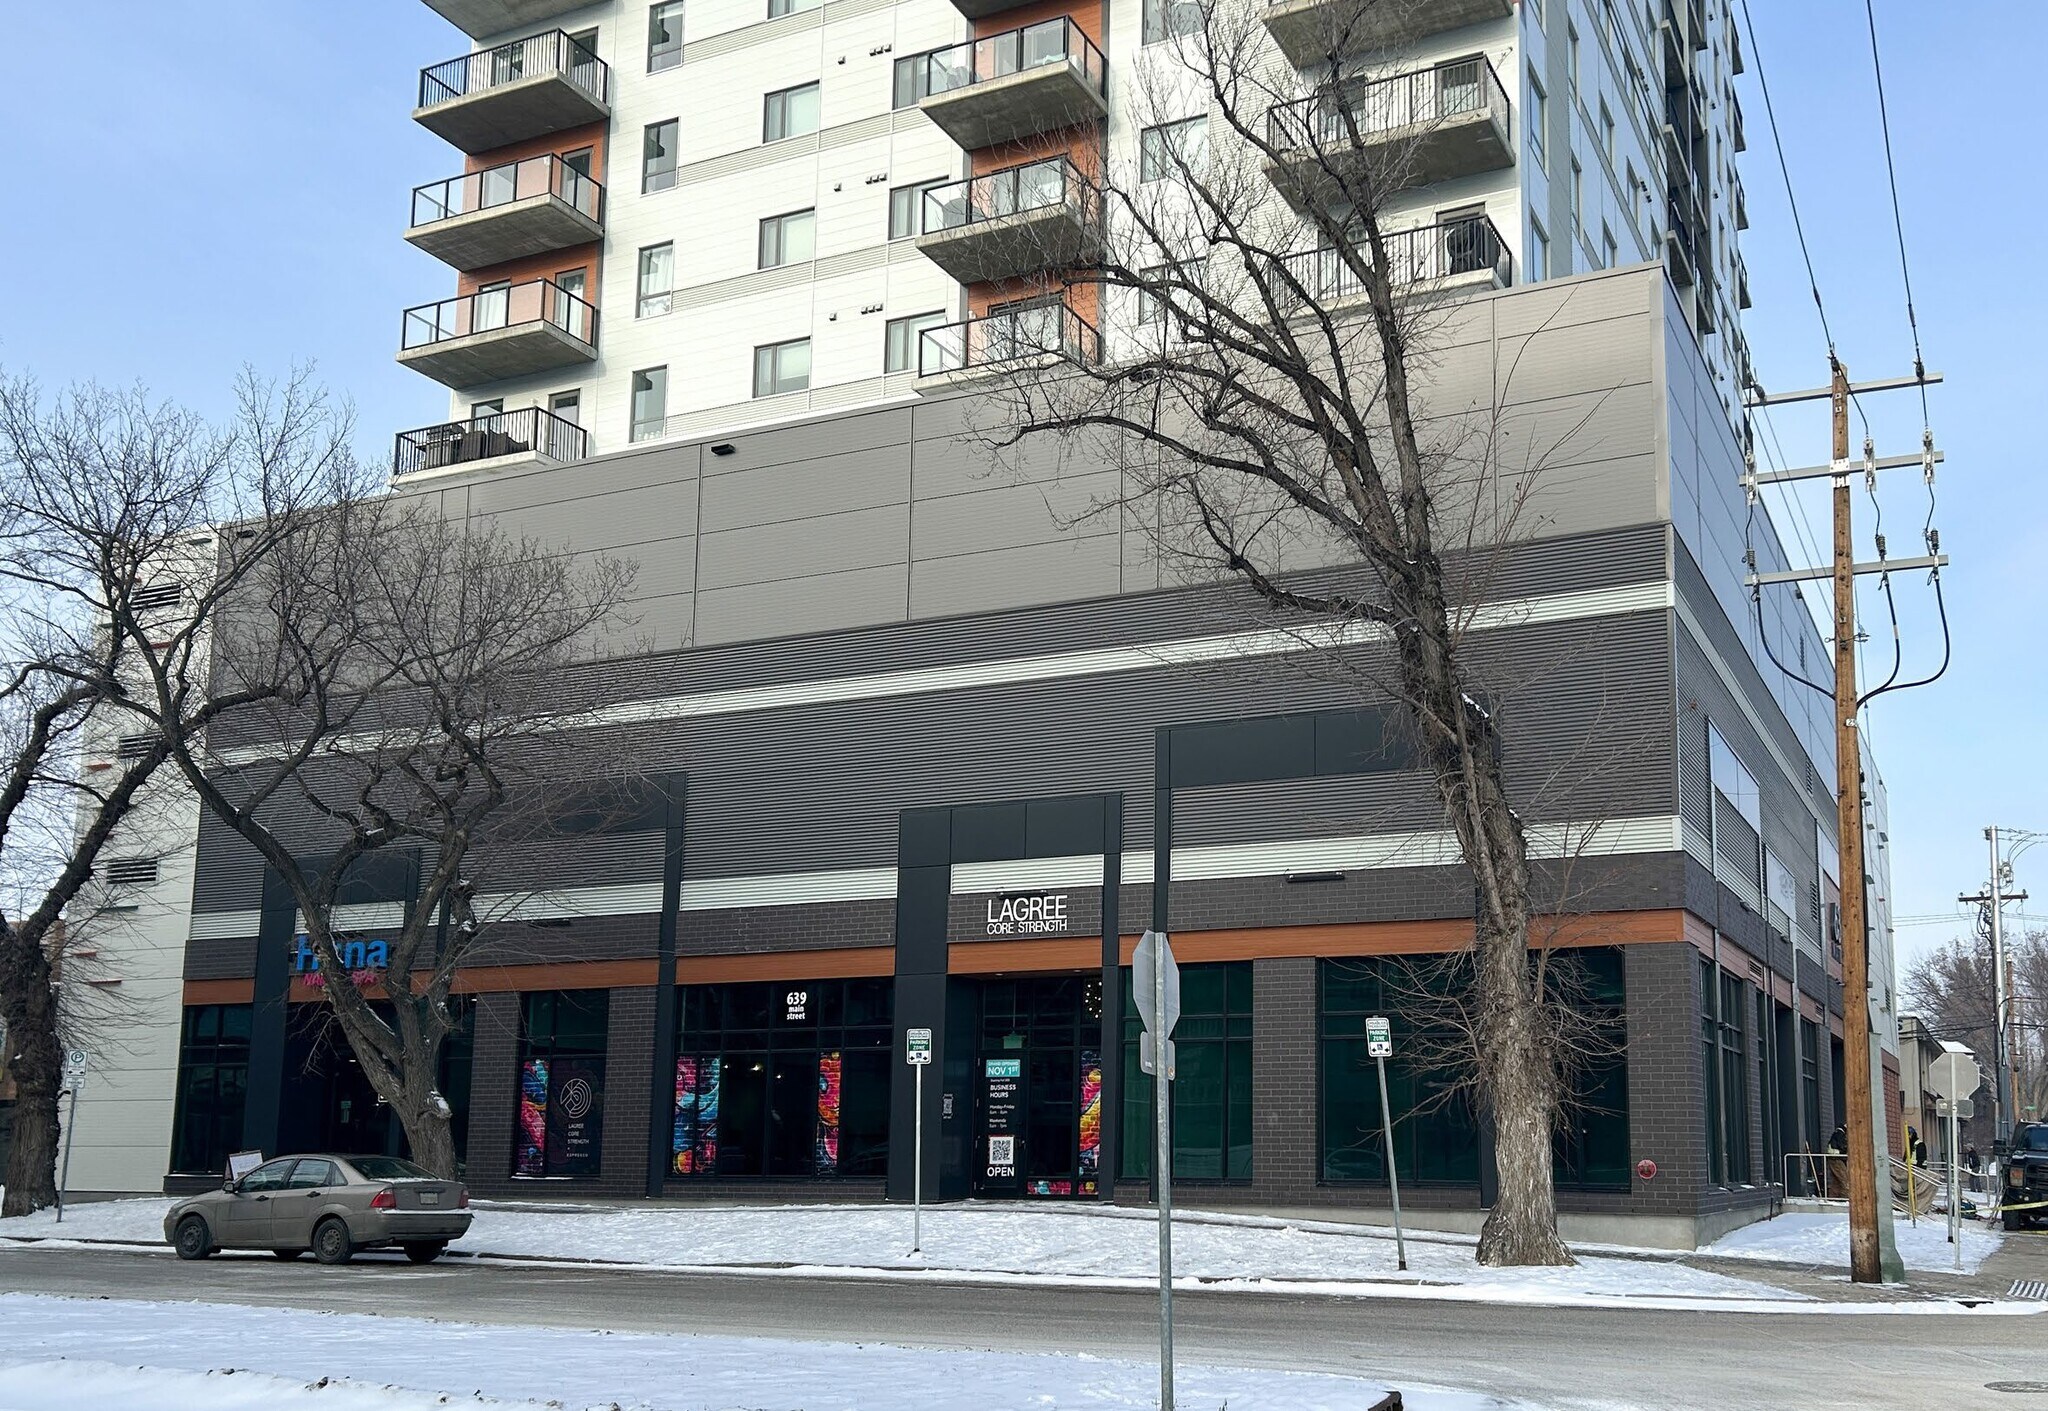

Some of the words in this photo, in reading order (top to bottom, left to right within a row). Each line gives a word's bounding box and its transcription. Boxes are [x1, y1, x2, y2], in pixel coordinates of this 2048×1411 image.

[987, 895, 1068, 923] LAGREE
[987, 922, 1015, 935] CORE
[1018, 919, 1068, 934] STRENGTH
[296, 935, 388, 971] Hna
[786, 991, 807, 1005] 639
[788, 1004, 805, 1013] main
[786, 1012, 806, 1020] street
[988, 1066, 1006, 1076] NOV
[1007, 1066, 1019, 1076] 1ST
[990, 1083, 1017, 1091] BUSINESS
[989, 1091, 1009, 1099] HOURS
[986, 1166, 1015, 1178] OPEN
